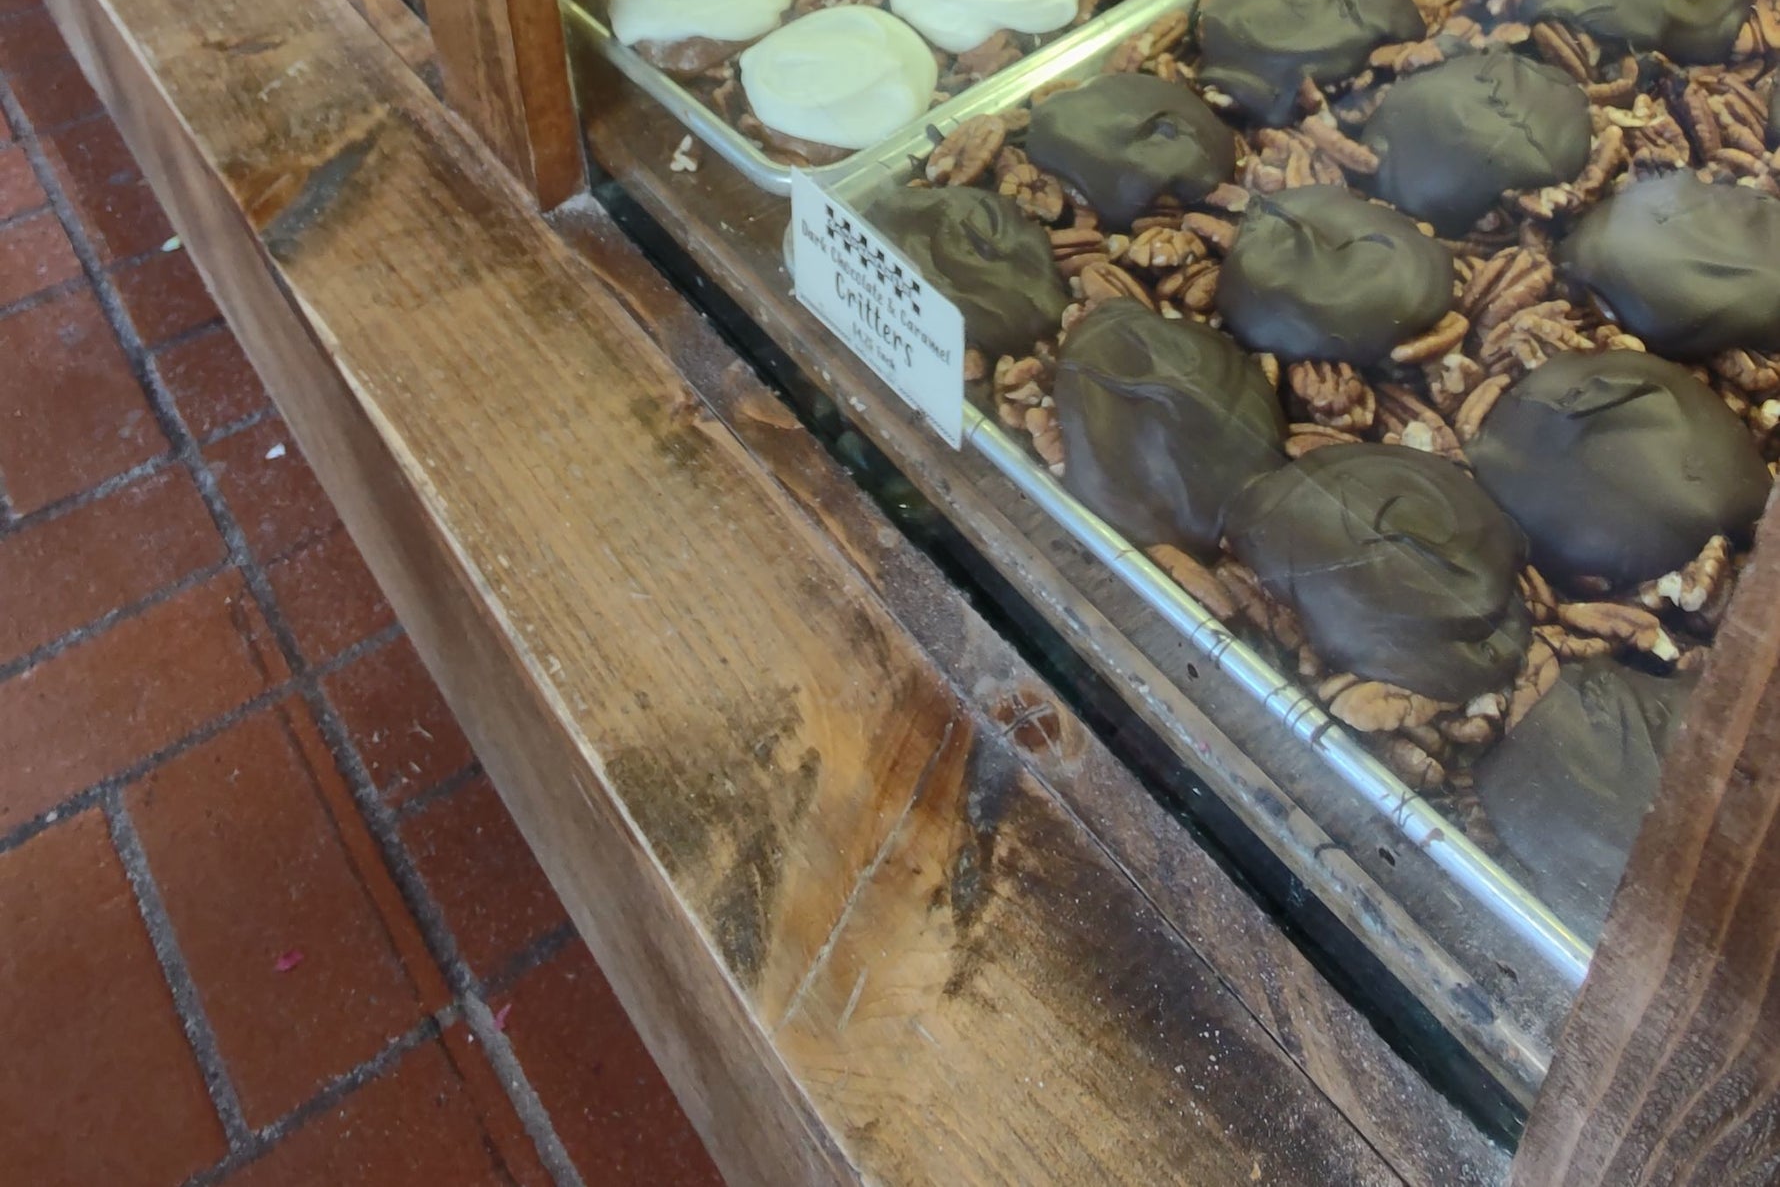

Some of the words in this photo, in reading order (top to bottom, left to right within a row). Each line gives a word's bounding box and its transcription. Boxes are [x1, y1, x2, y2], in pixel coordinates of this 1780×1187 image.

[801, 218, 827, 254] Dark
[830, 245, 884, 306] Chocolate
[900, 309, 950, 365] Caramel
[836, 270, 912, 367] Critters
